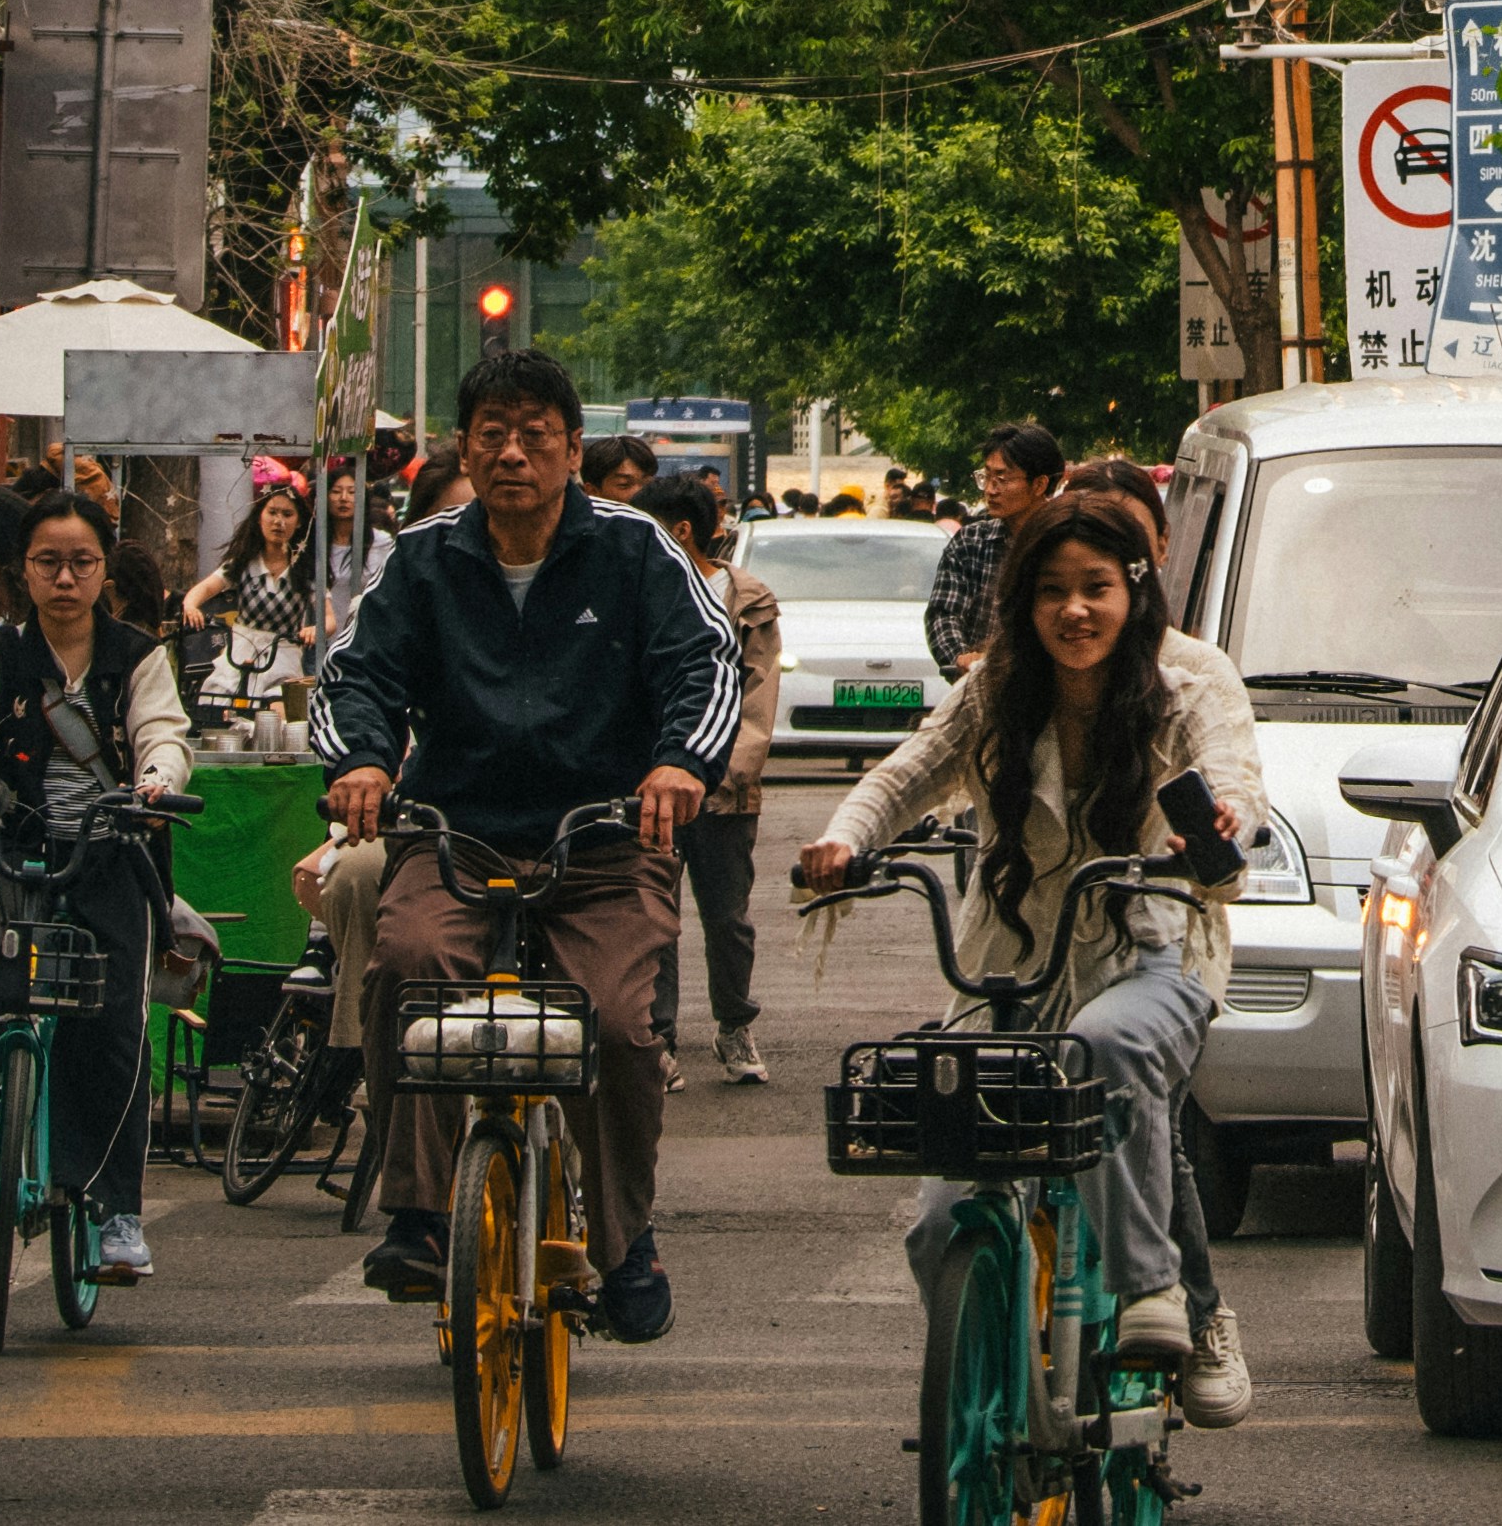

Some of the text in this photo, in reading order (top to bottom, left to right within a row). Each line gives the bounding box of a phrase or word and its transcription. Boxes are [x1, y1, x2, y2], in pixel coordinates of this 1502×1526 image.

[1470, 88, 1498, 103] 50m
[1365, 266, 1441, 309] 机动
[1185, 317, 1239, 348] 禁止
